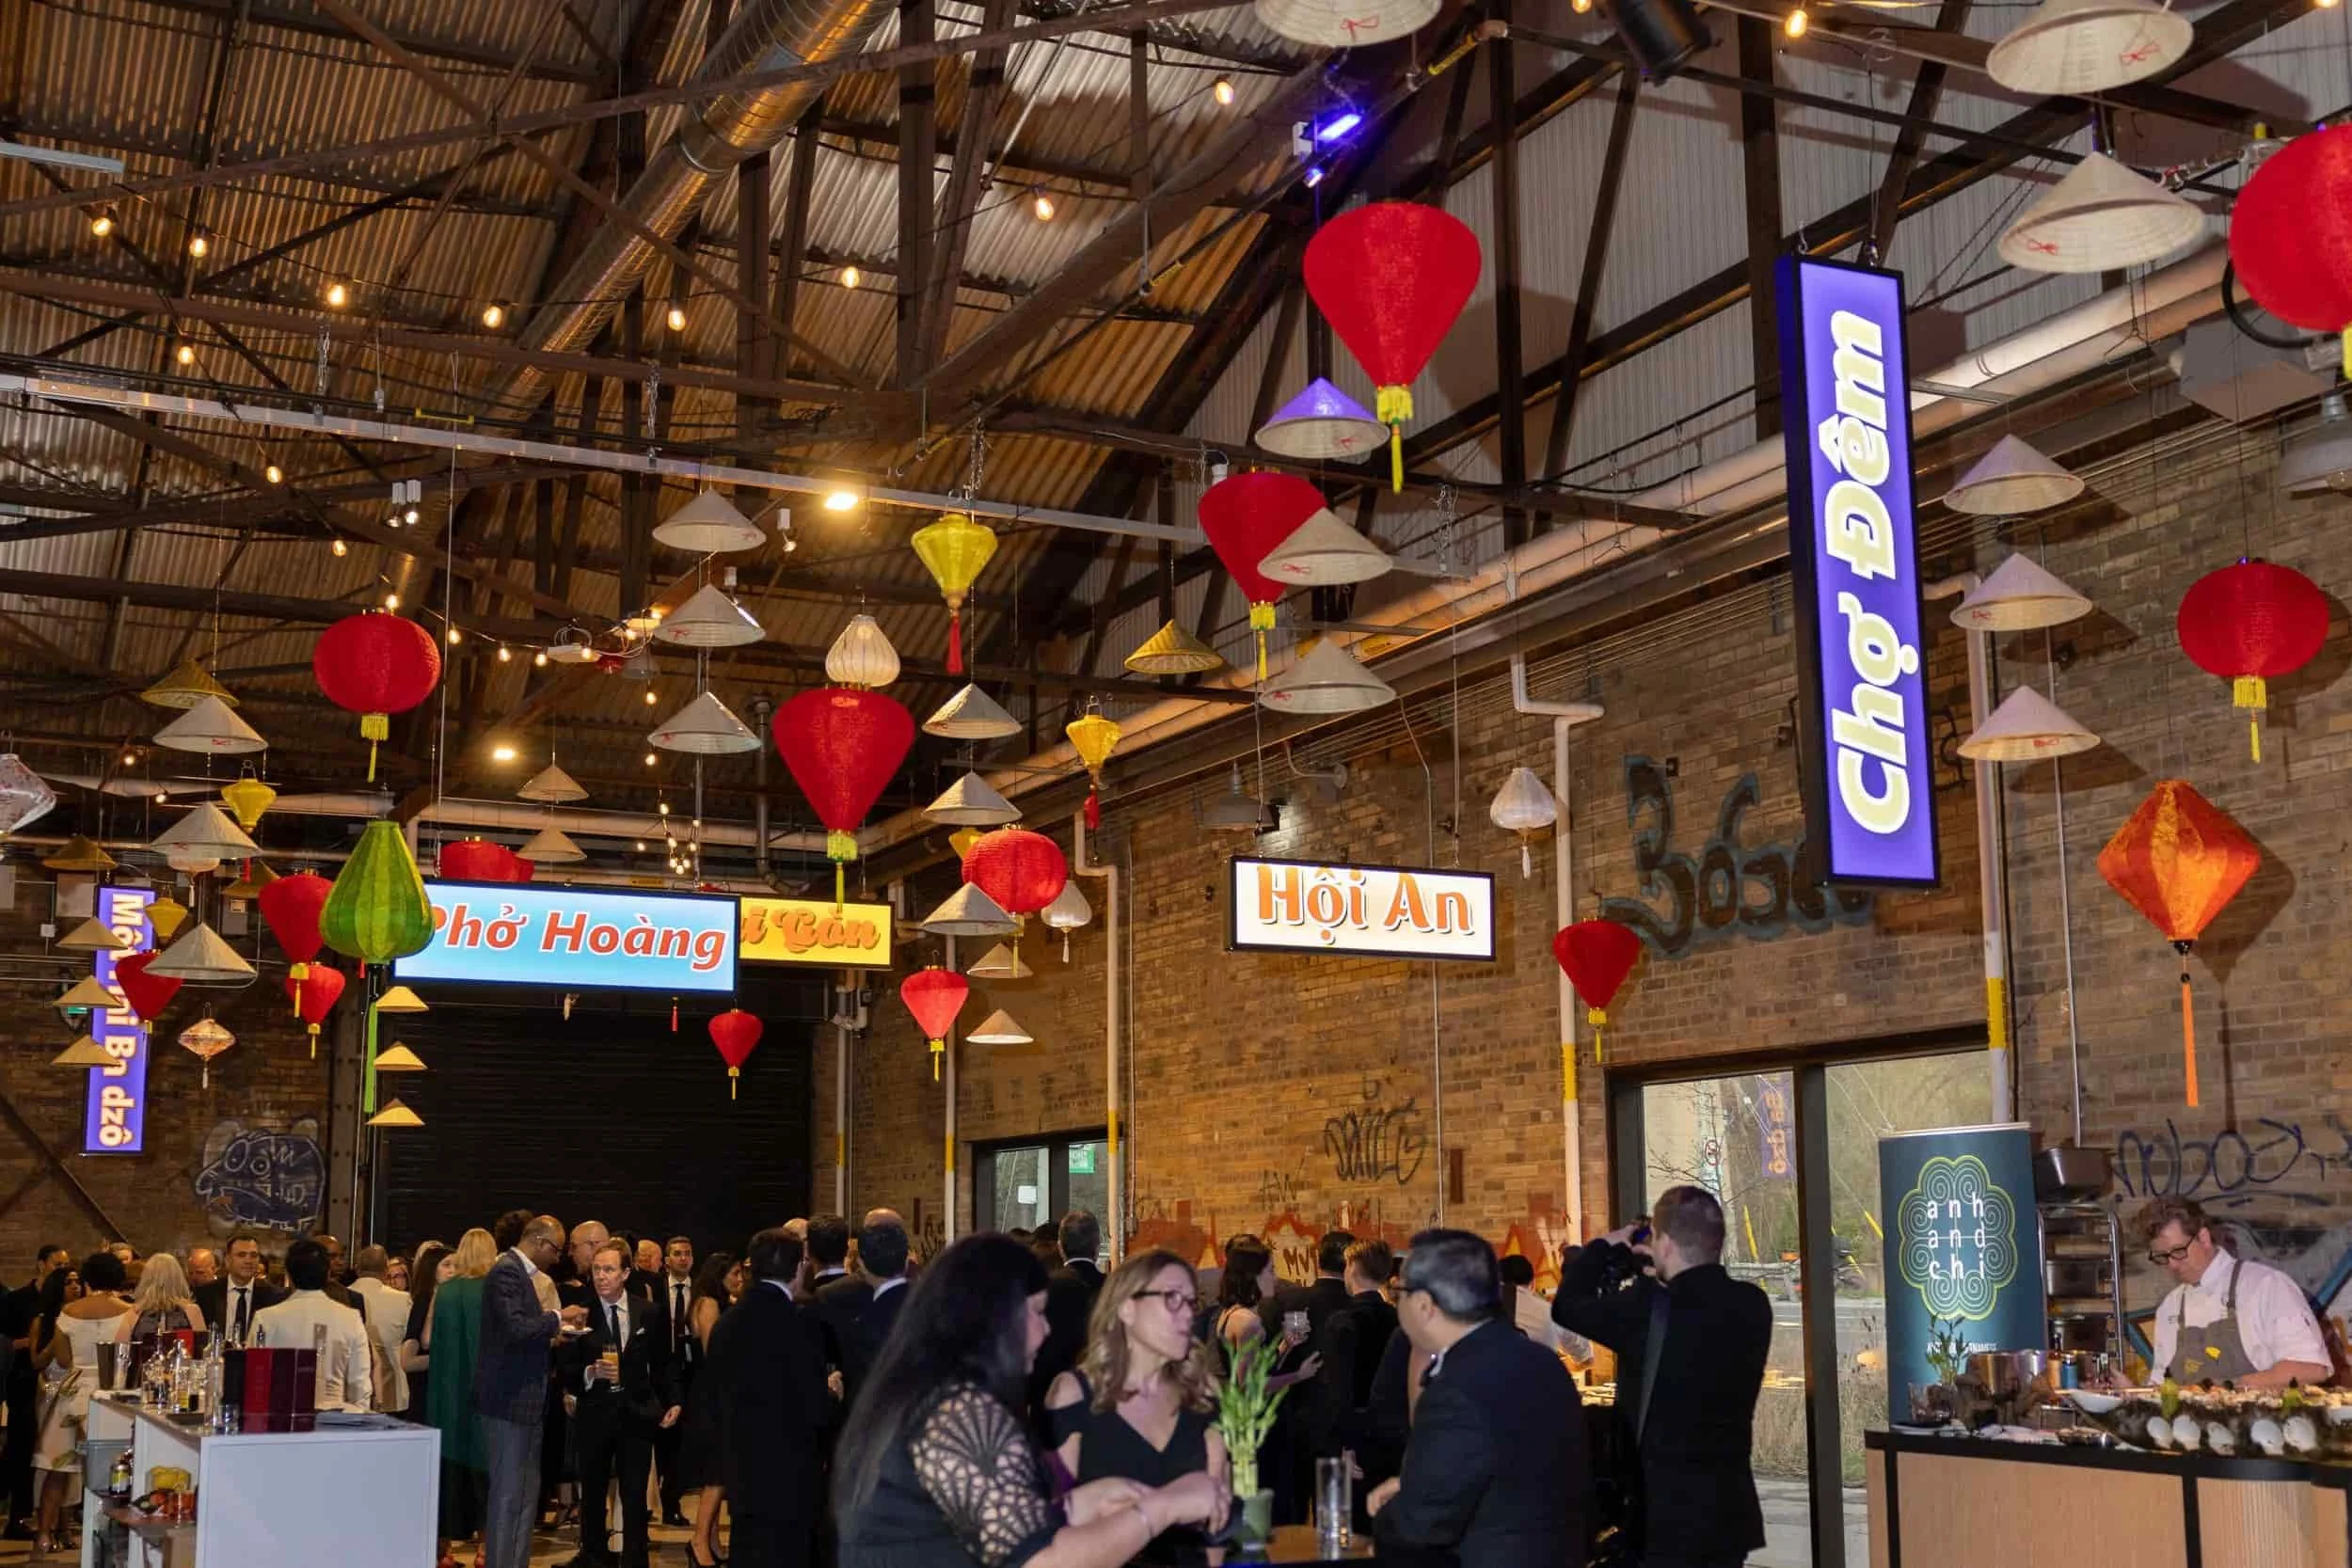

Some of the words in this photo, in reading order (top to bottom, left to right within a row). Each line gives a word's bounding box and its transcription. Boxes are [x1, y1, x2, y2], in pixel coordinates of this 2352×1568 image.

[1819, 309, 1897, 579] Đêm
[1831, 594, 1918, 834] Chợ
[1257, 865, 1369, 944] Hội
[1383, 872, 1475, 935] An
[540, 910, 730, 973] Hoàng
[99, 1085, 135, 1147] dzô
[1927, 1192, 1984, 1219] anh
[1928, 1221, 1986, 1249] and
[1929, 1253, 1985, 1280] chi
